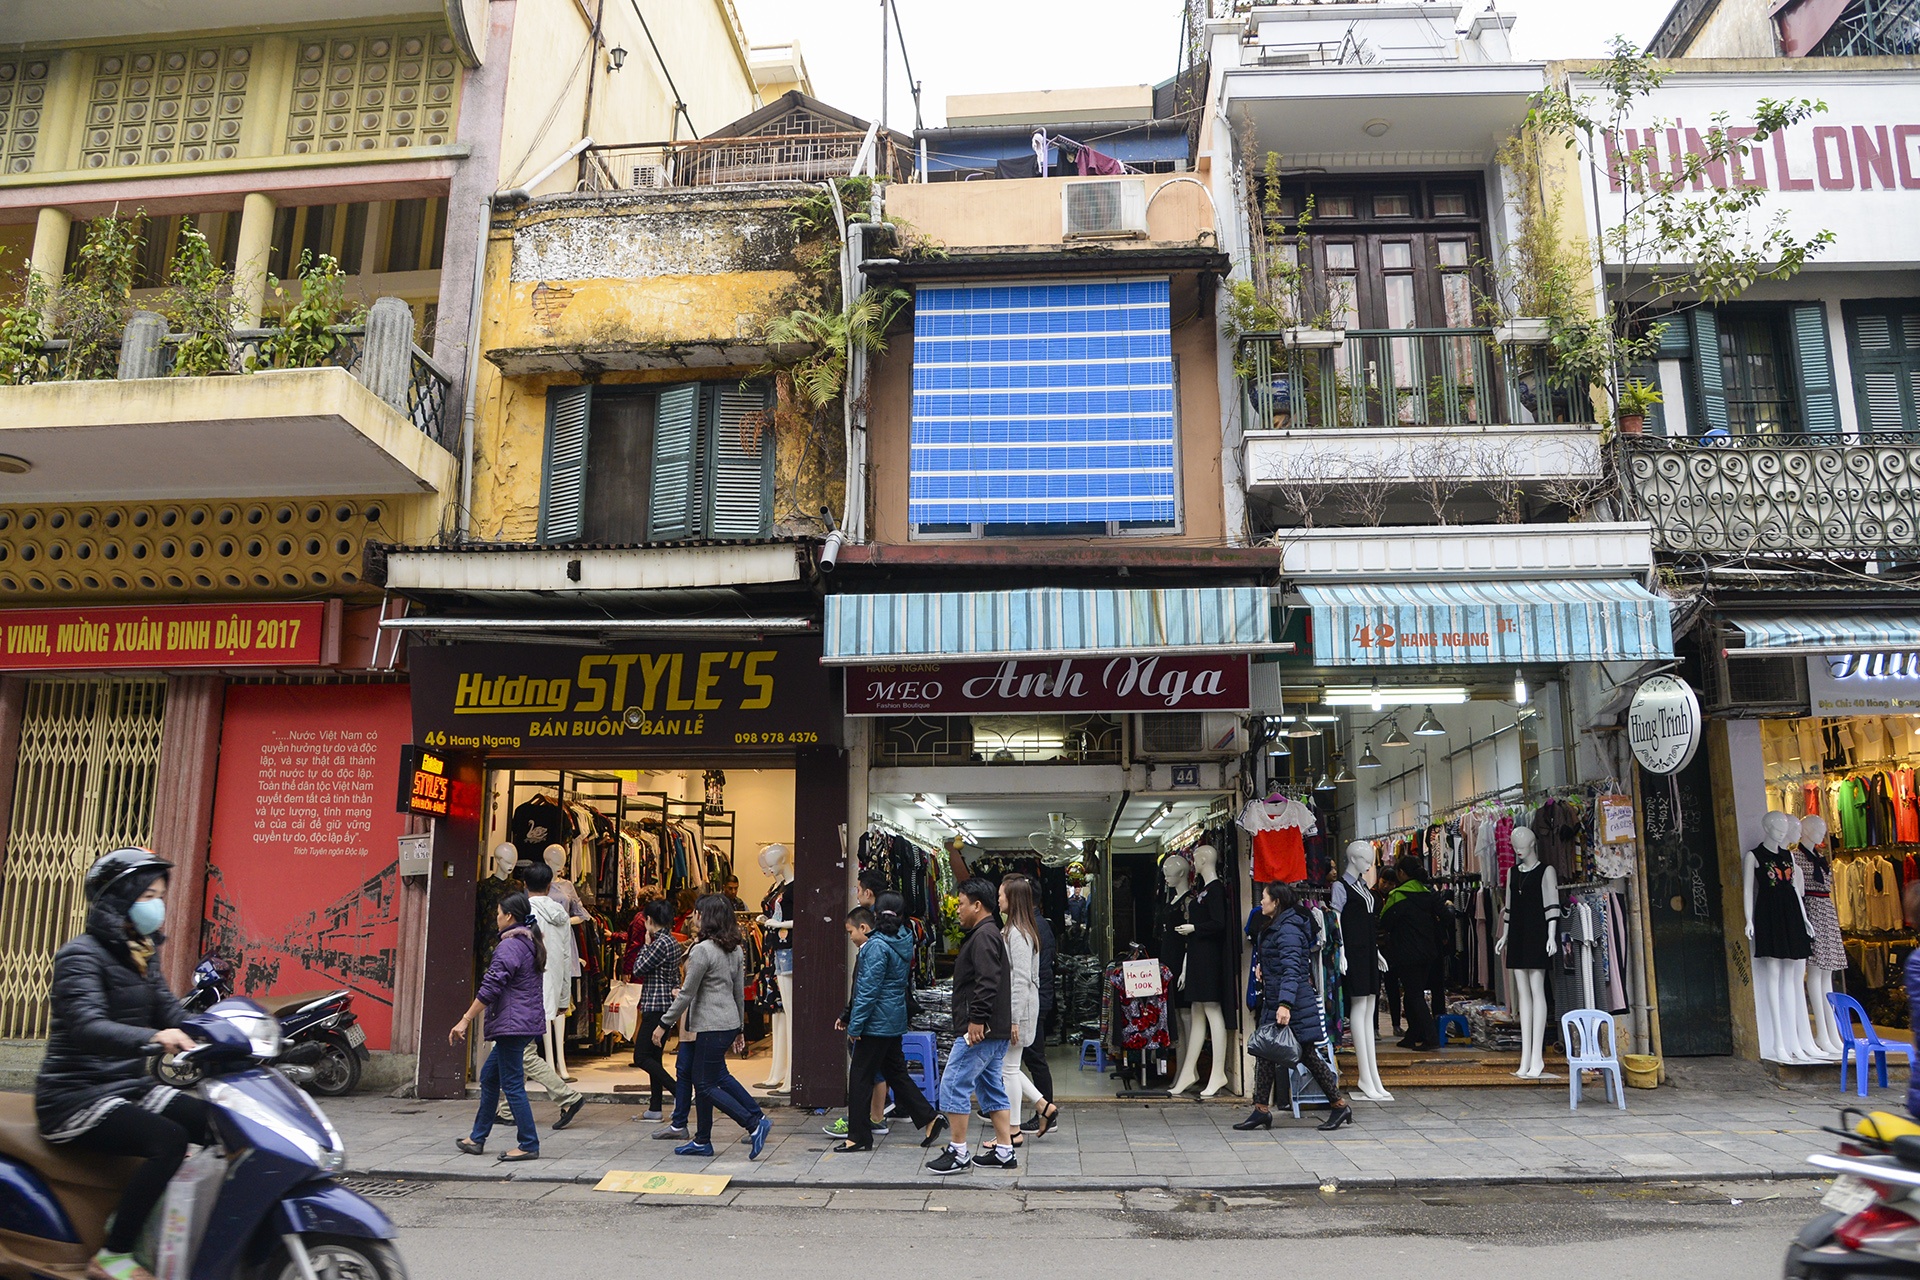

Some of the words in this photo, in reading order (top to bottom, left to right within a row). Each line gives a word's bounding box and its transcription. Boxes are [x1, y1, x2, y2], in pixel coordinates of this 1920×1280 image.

[7, 624, 51, 656] VINH,
[56, 616, 110, 653] MỪNG
[113, 616, 164, 651] XUÂN
[167, 620, 210, 650] ĐINH
[215, 613, 251, 656] DẬU
[255, 619, 301, 649] 2017
[1352, 623, 1396, 649] 42
[1401, 632, 1438, 647] HANG
[1442, 632, 1490, 647] NGANG
[901, 663, 941, 673] NGANG
[454, 673, 571, 714] Hương
[573, 651, 778, 711] STYLE'S
[961, 659, 1088, 699] Anh
[1102, 656, 1227, 706] Nga
[866, 681, 943, 701] MEO
[1853, 699, 1865, 707] 40
[1866, 698, 1889, 709] Hàng
[1891, 698, 1920, 708] Ngang
[529, 717, 568, 737] BÁN
[572, 714, 625, 736] BUÔN
[641, 715, 679, 735] BÁN
[684, 713, 704, 735] LẺ
[319, 731, 337, 741] Việt
[340, 730, 363, 740] Nam
[366, 730, 378, 740] có
[424, 731, 447, 746] 46
[450, 735, 480, 748] Hang
[482, 735, 521, 748] Ngang
[735, 732, 758, 744] 098
[761, 732, 785, 743] 978
[788, 731, 818, 743] 4376
[1630, 714, 1660, 752] Hùng
[261, 741, 289, 755] quyền
[290, 742, 321, 755] hưởng
[322, 743, 333, 754] tự
[334, 743, 346, 752] do
[347, 743, 358, 752] và
[359, 743, 378, 754] độc
[260, 755, 276, 767] lập,
[281, 755, 292, 765] và
[295, 757, 309, 767] sự
[312, 755, 329, 767] thật
[333, 755, 346, 765] đã
[350, 755, 376, 765] thành
[259, 768, 276, 779] một
[280, 768, 305, 778] nước
[307, 769, 319, 779] tự
[321, 768, 334, 778] do
[336, 768, 355, 779] độc
[357, 768, 375, 780] lập.
[1176, 769, 1194, 783] 44
[258, 780, 280, 790] Toàn
[281, 779, 296, 790] thể
[297, 781, 315, 790] dân
[316, 781, 331, 792] tộc
[332, 781, 351, 792] Việt
[351, 781, 374, 791] Nam
[256, 792, 282, 805] quyết
[283, 793, 304, 803] đem
[305, 792, 318, 803] tất
[319, 793, 331, 803] cả
[333, 793, 350, 803] tinh
[352, 792, 373, 803] thần
[255, 806, 267, 816] và
[270, 806, 286, 817] lực
[288, 806, 319, 818] lượng,
[323, 806, 342, 816] tính
[345, 808, 372, 819] mạng
[254, 818, 266, 829] và
[270, 818, 287, 829] của
[291, 818, 306, 829] cải
[309, 817, 322, 829] để
[326, 819, 342, 832] giữ
[346, 819, 371, 832] vững
[252, 830, 281, 844] quyền
[282, 832, 293, 843] tự
[293, 832, 308, 843] do,
[309, 832, 328, 843] độc
[328, 832, 343, 844] lập
[309, 846, 328, 857] Tuyên
[328, 847, 344, 857] ngôn
[344, 846, 358, 856] Độc
